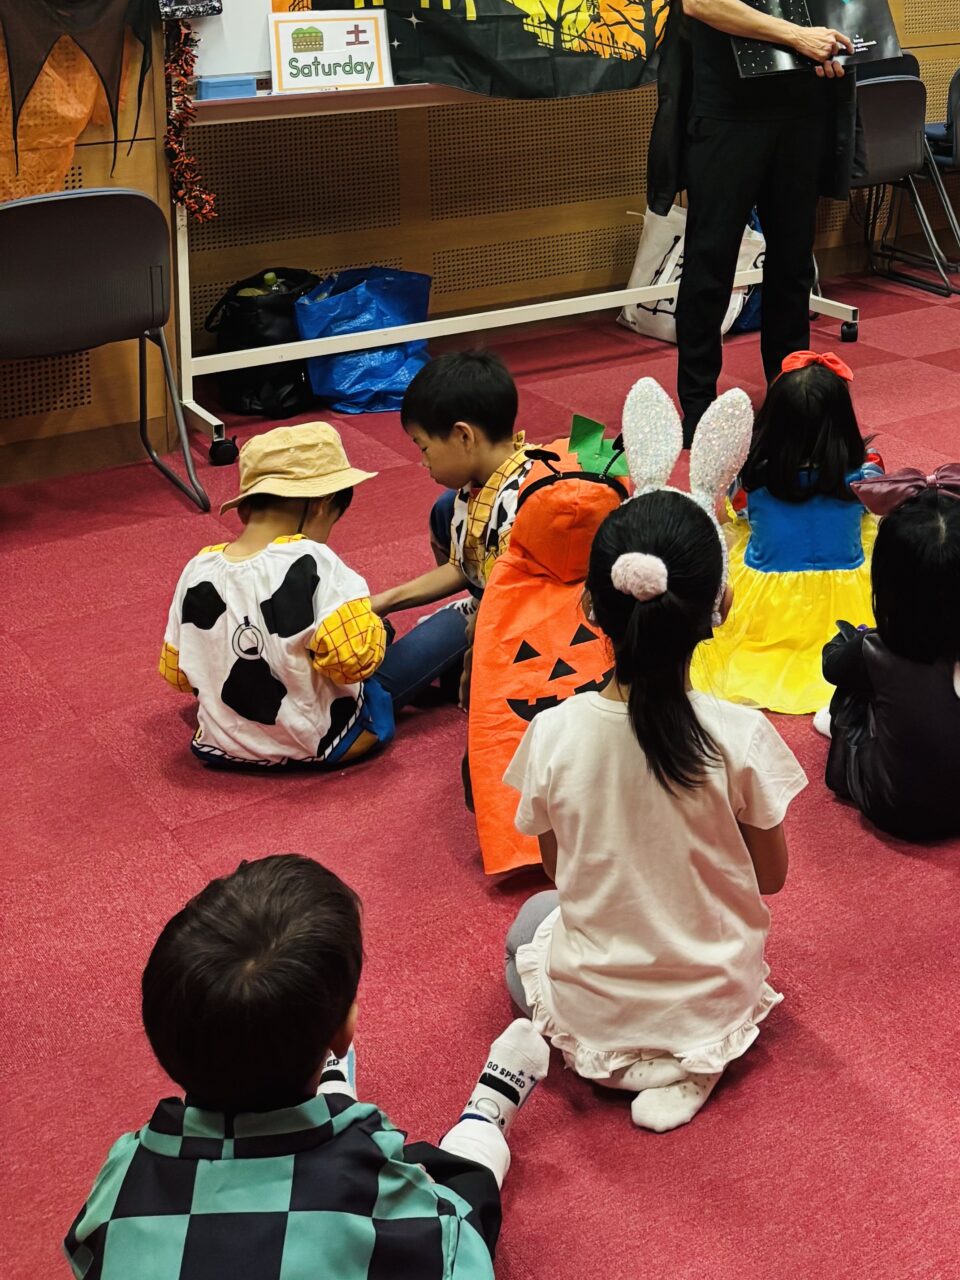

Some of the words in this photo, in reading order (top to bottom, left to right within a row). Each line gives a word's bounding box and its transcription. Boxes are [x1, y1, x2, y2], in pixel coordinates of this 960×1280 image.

[346, 24, 369, 46] 土
[288, 54, 375, 82] Saturday
[486, 1061, 499, 1072] GO
[499, 1067, 526, 1089] SPEED
